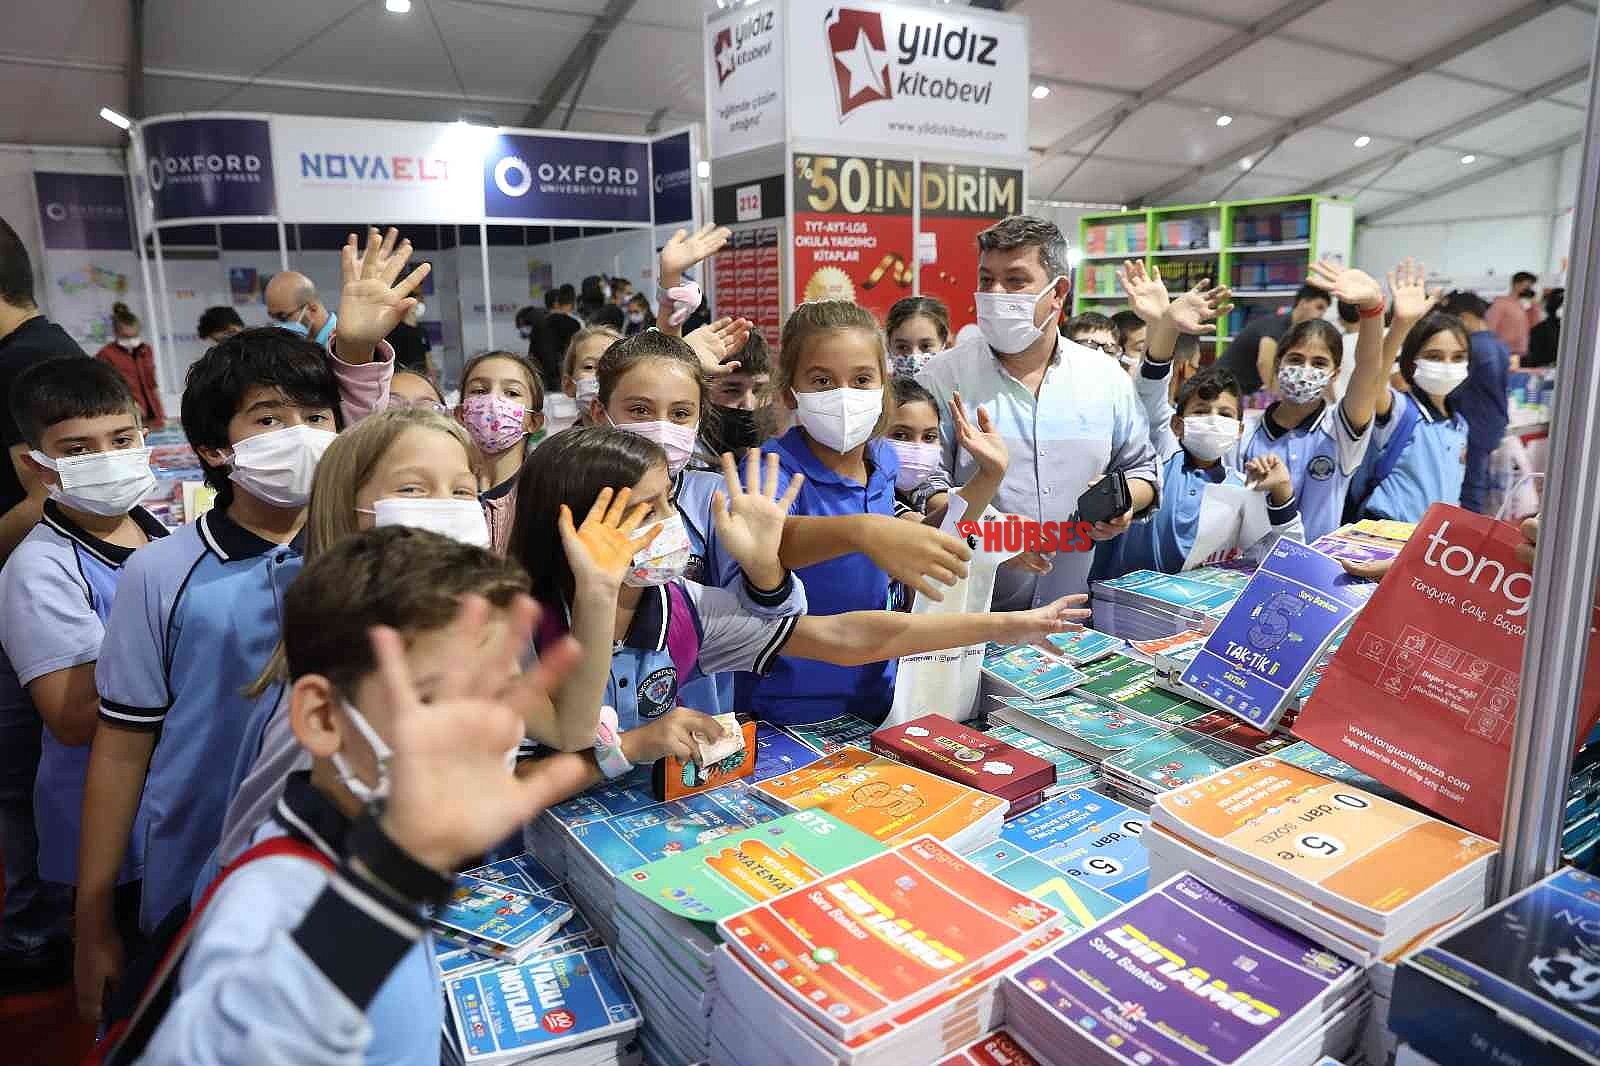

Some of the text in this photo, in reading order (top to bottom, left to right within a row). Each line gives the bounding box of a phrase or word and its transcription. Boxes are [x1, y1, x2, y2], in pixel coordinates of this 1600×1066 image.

[897, 22, 999, 66] yıldız
[897, 71, 993, 105] kitabevi
[165, 154, 261, 173] OXFORD
[537, 163, 640, 185] OXFORD
[540, 184, 638, 197] UNIVERSITY PRESS
[1225, 641, 1271, 673] TAK-TİK
[793, 811, 837, 836] BTS
[1088, 937, 1119, 960] Soru
[1116, 956, 1169, 993] Bankası
[497, 968, 539, 1033] NOTLARI
[529, 962, 566, 1010] YAZILI
